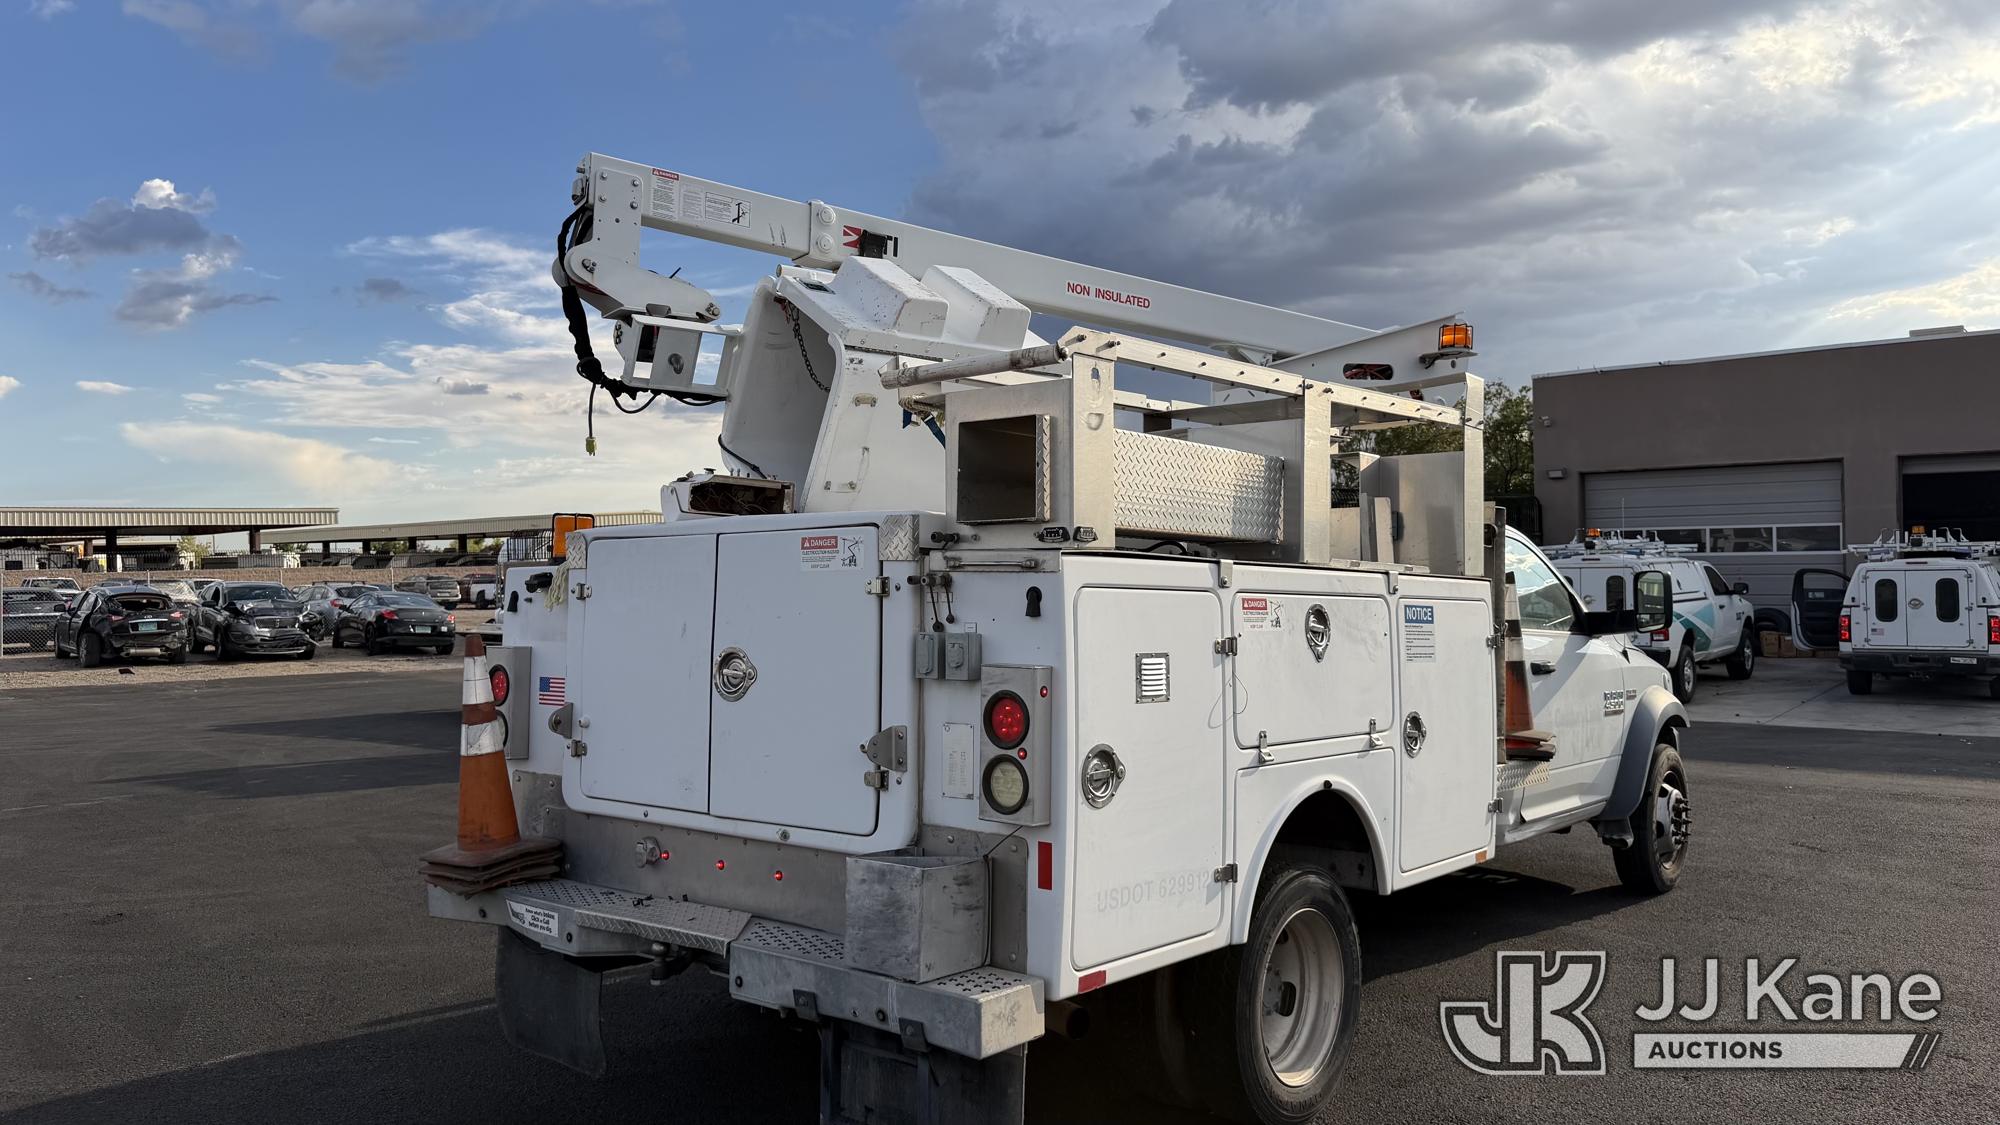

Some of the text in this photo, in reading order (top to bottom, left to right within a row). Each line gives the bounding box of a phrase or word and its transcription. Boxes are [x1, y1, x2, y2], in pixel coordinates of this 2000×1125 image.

[1067, 282, 1151, 309] NON INSULATED
[810, 538, 836, 547] DANGER
[1247, 600, 1266, 608] DANGER
[1406, 607, 1433, 621] NOTICE
[1097, 870, 1210, 913] USDOT 629912
